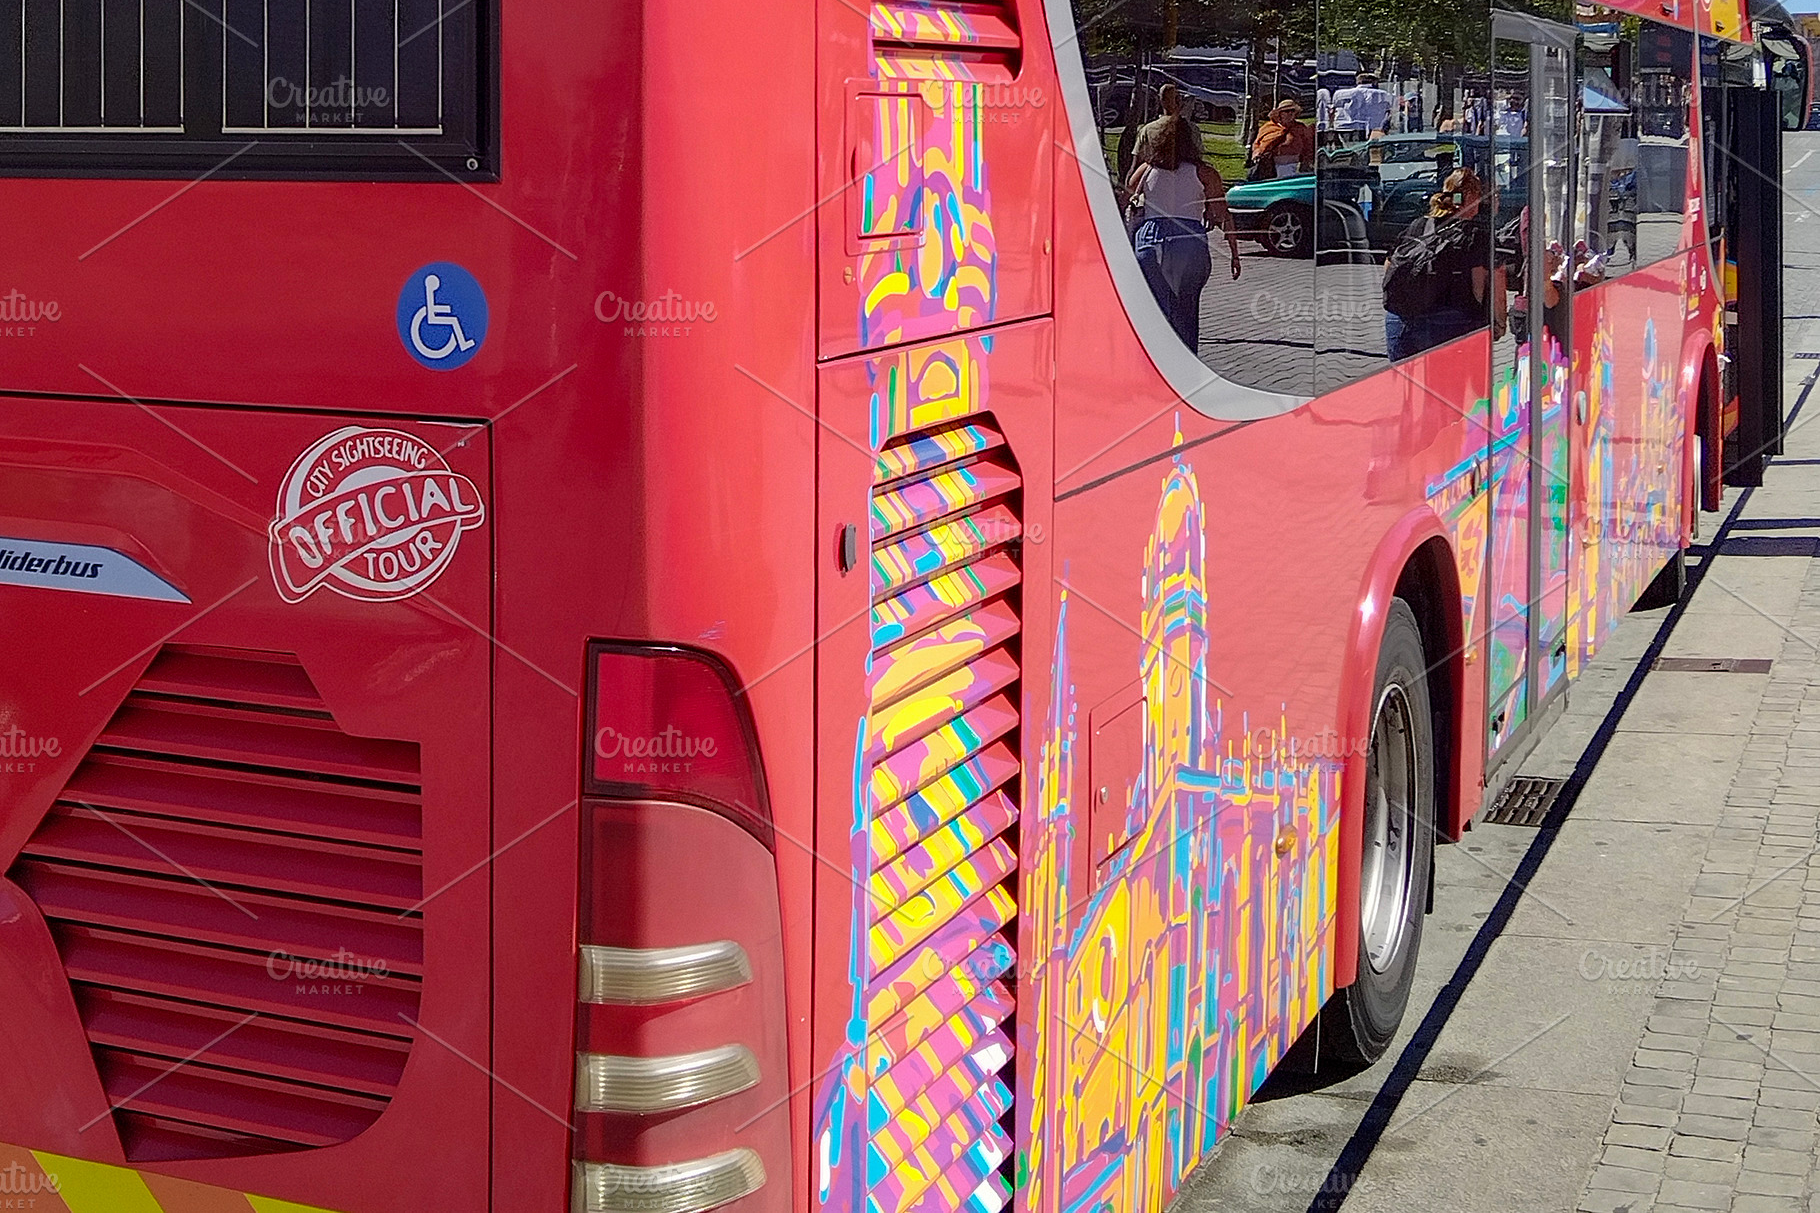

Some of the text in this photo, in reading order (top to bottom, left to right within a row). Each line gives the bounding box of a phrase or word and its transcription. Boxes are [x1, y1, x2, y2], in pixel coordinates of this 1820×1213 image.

[307, 437, 428, 497] CITY SIGHTSEEING
[289, 478, 474, 568] OFFICIAL
[0, 549, 104, 578] liderbus
[364, 531, 442, 579] TOUR
